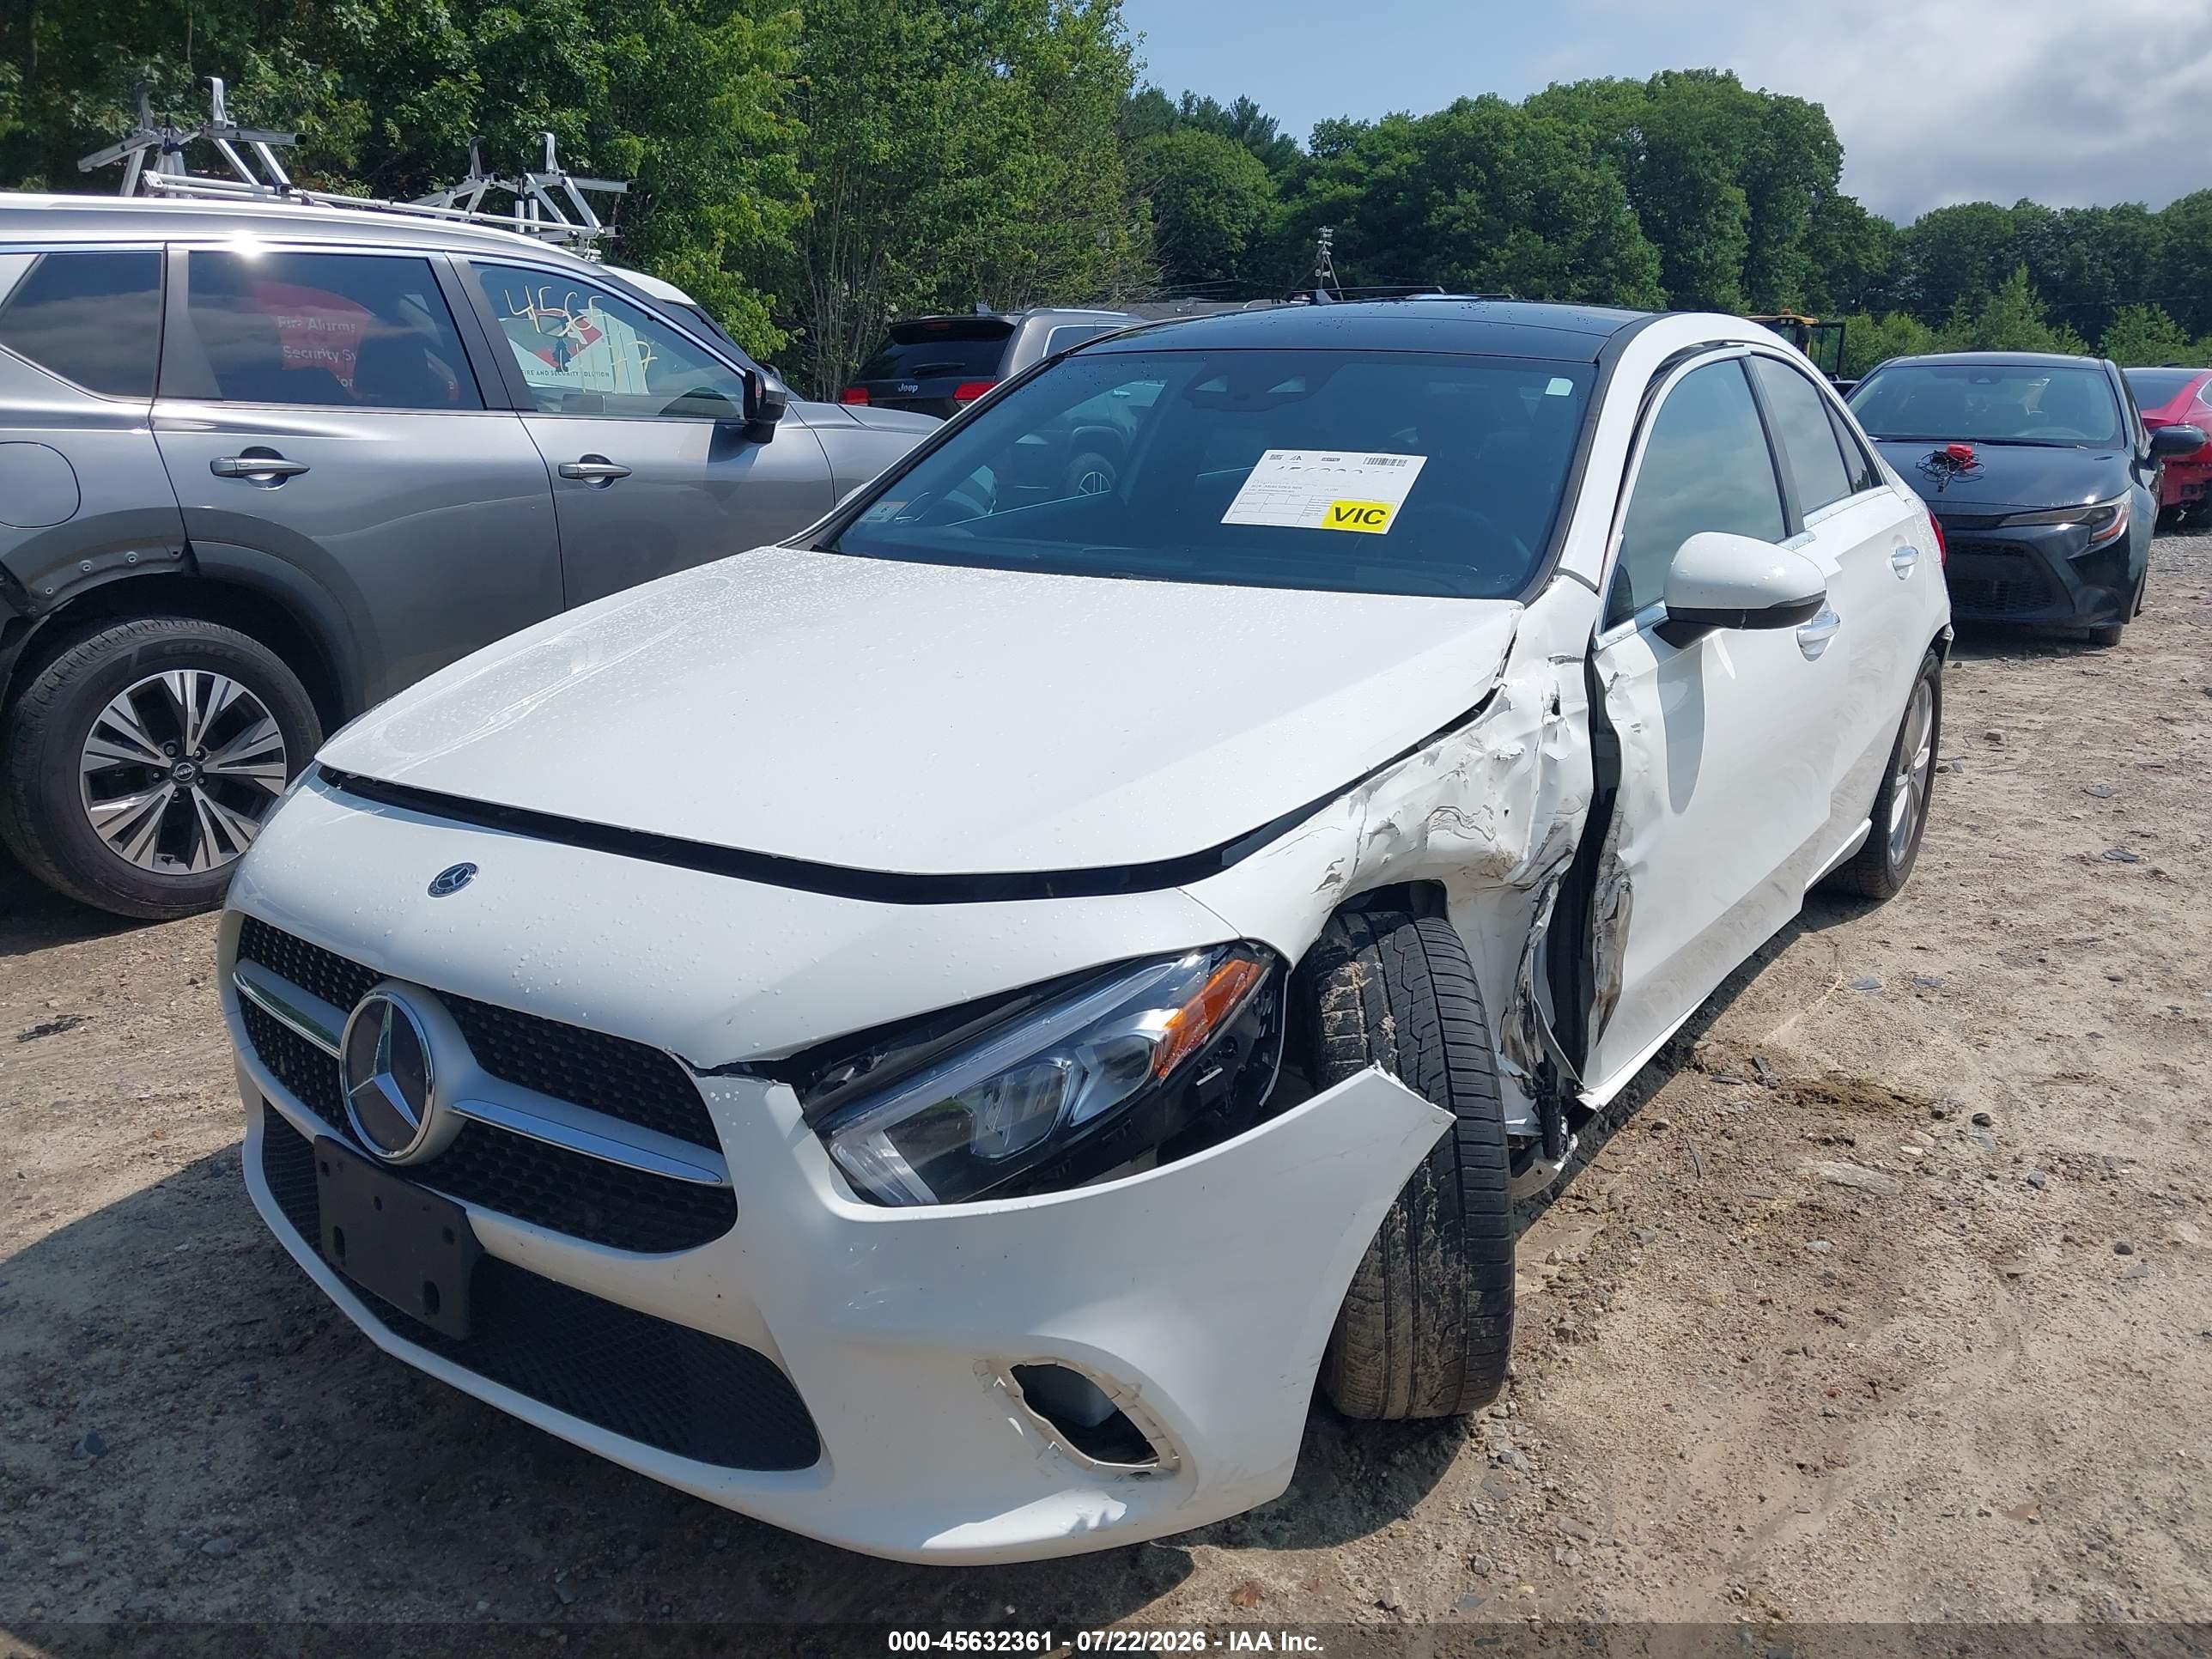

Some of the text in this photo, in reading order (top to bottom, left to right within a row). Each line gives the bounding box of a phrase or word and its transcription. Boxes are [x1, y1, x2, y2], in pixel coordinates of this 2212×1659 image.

[307, 317, 356, 333] Alarms
[283, 345, 340, 364] Security
[897, 382, 919, 394] Jeep
[1334, 507, 1387, 526] VIC
